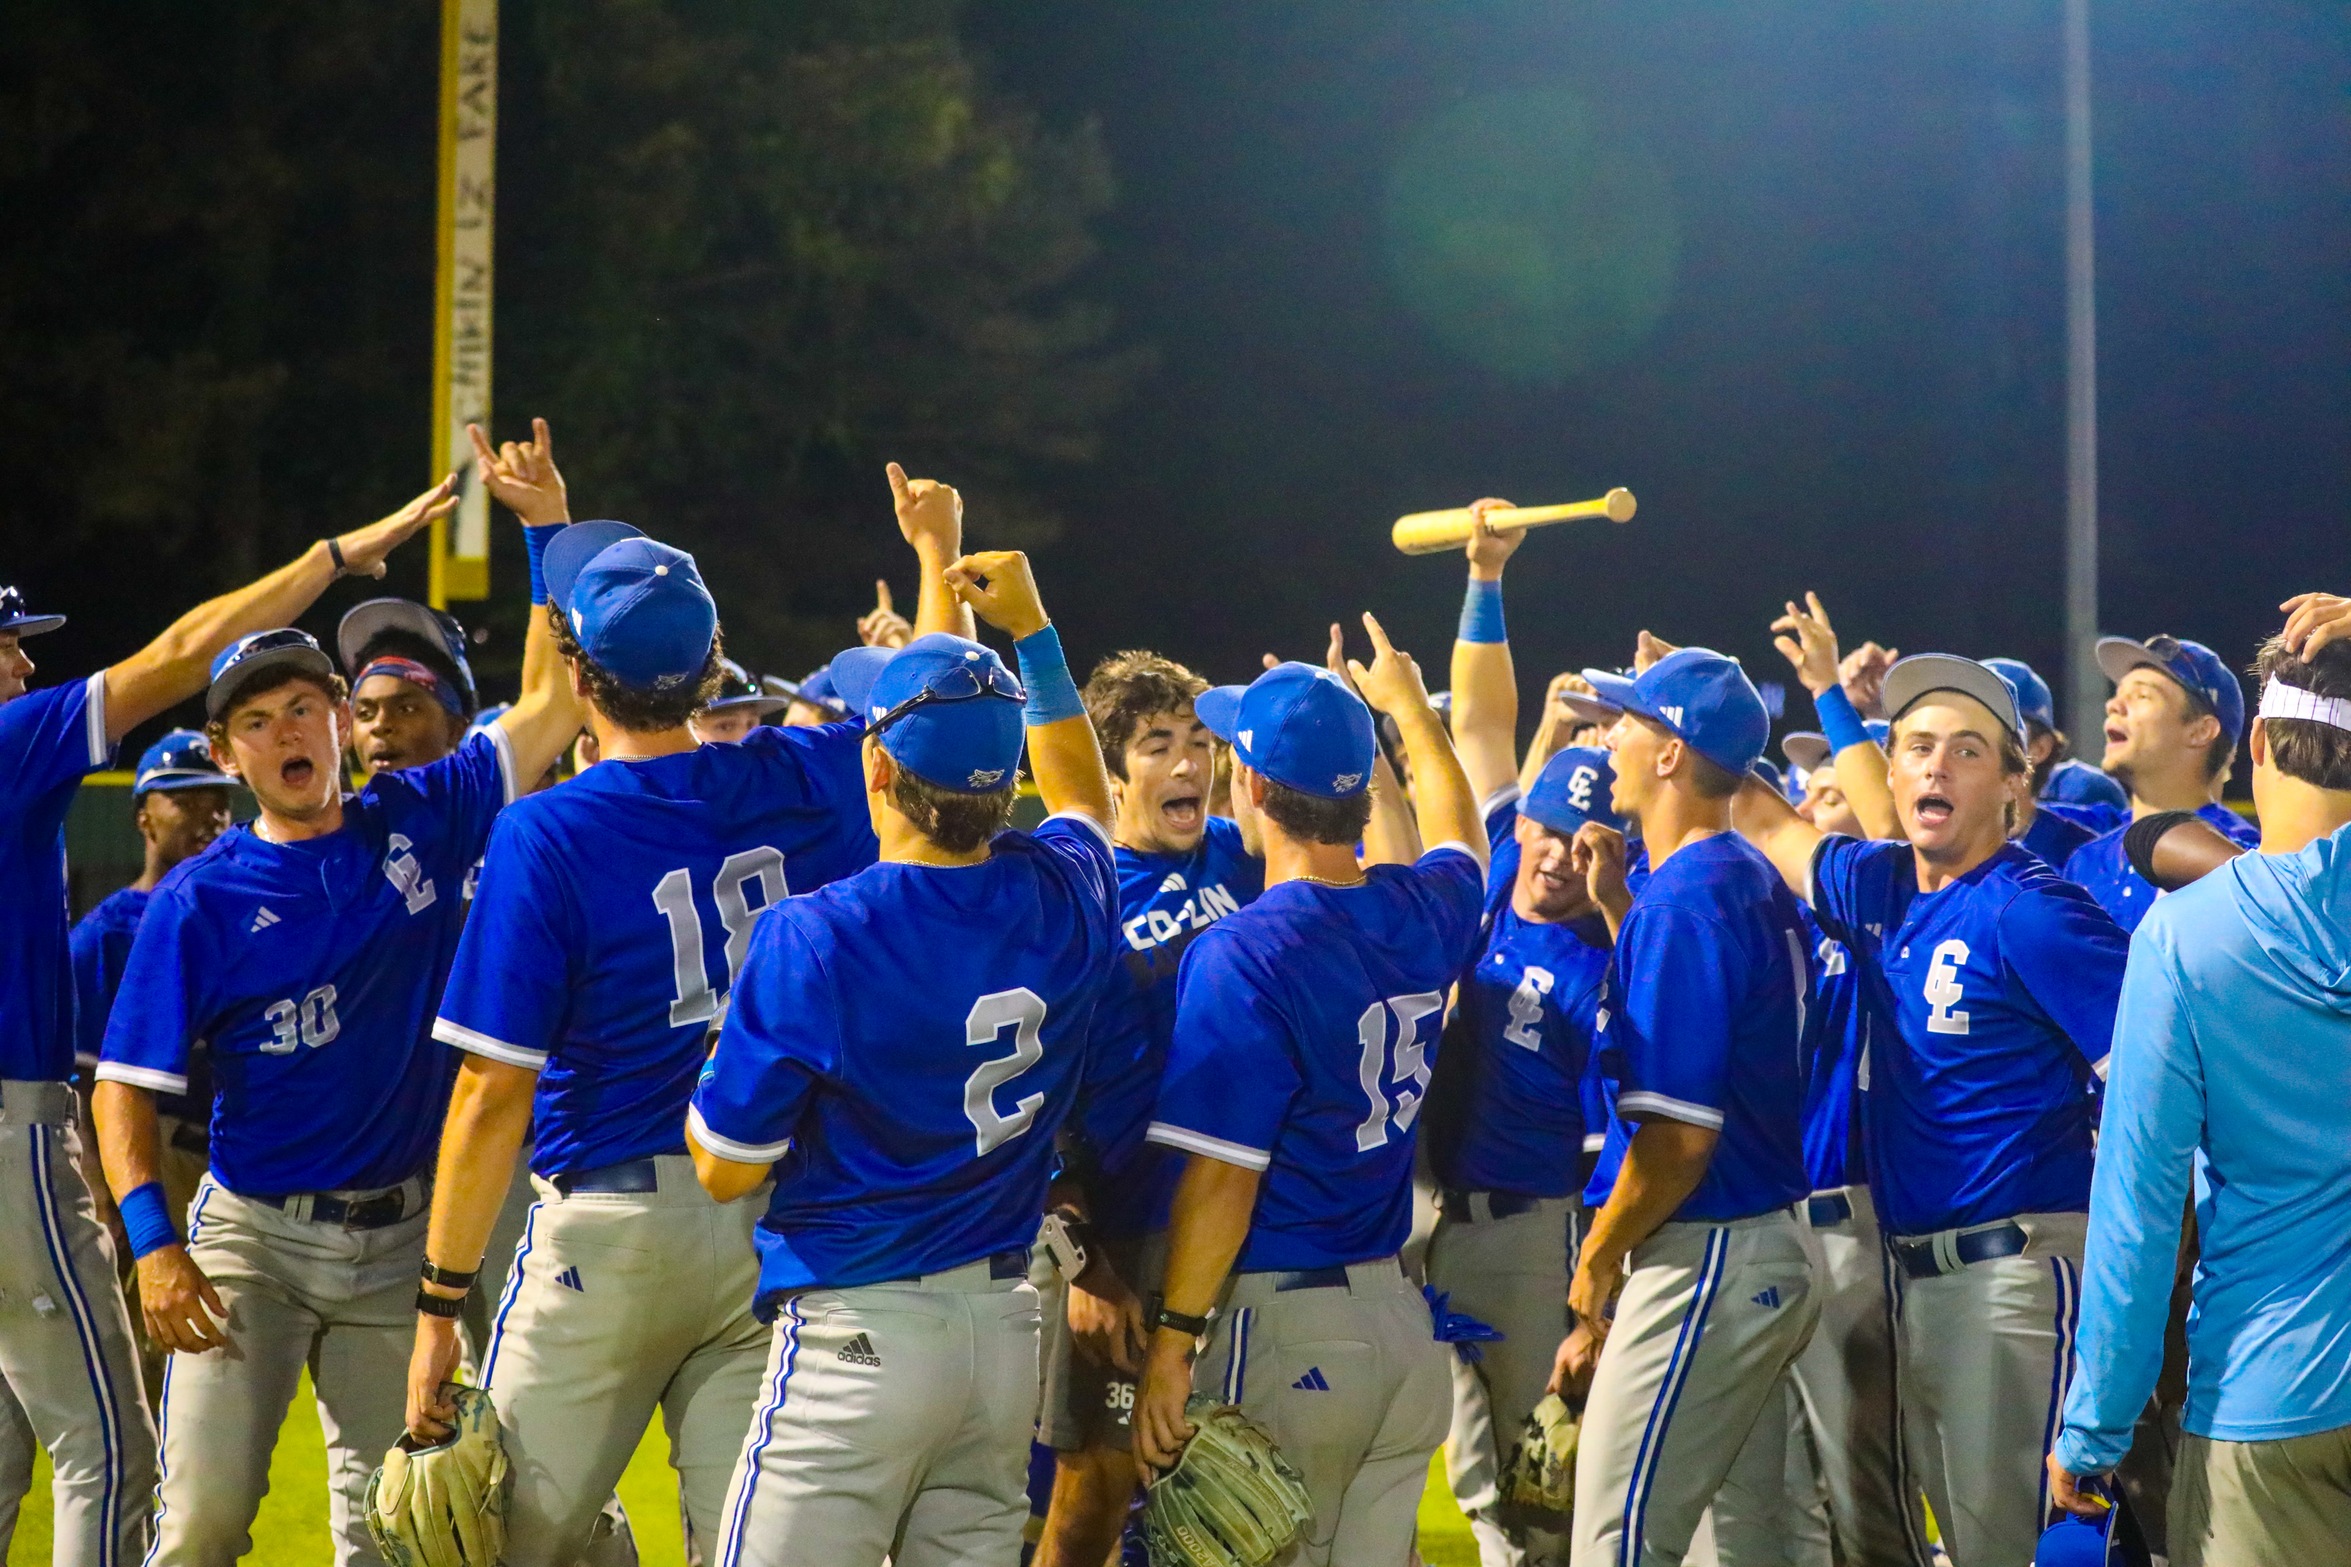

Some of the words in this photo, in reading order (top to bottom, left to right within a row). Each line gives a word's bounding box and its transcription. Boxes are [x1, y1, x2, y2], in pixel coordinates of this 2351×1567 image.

[1121, 883, 1241, 951] CO-LIN
[259, 984, 340, 1055] 30
[964, 987, 1047, 1157] 2
[1357, 990, 1443, 1153] 15
[837, 1350, 881, 1367] adidas
[1105, 1381, 1136, 1410] 36
